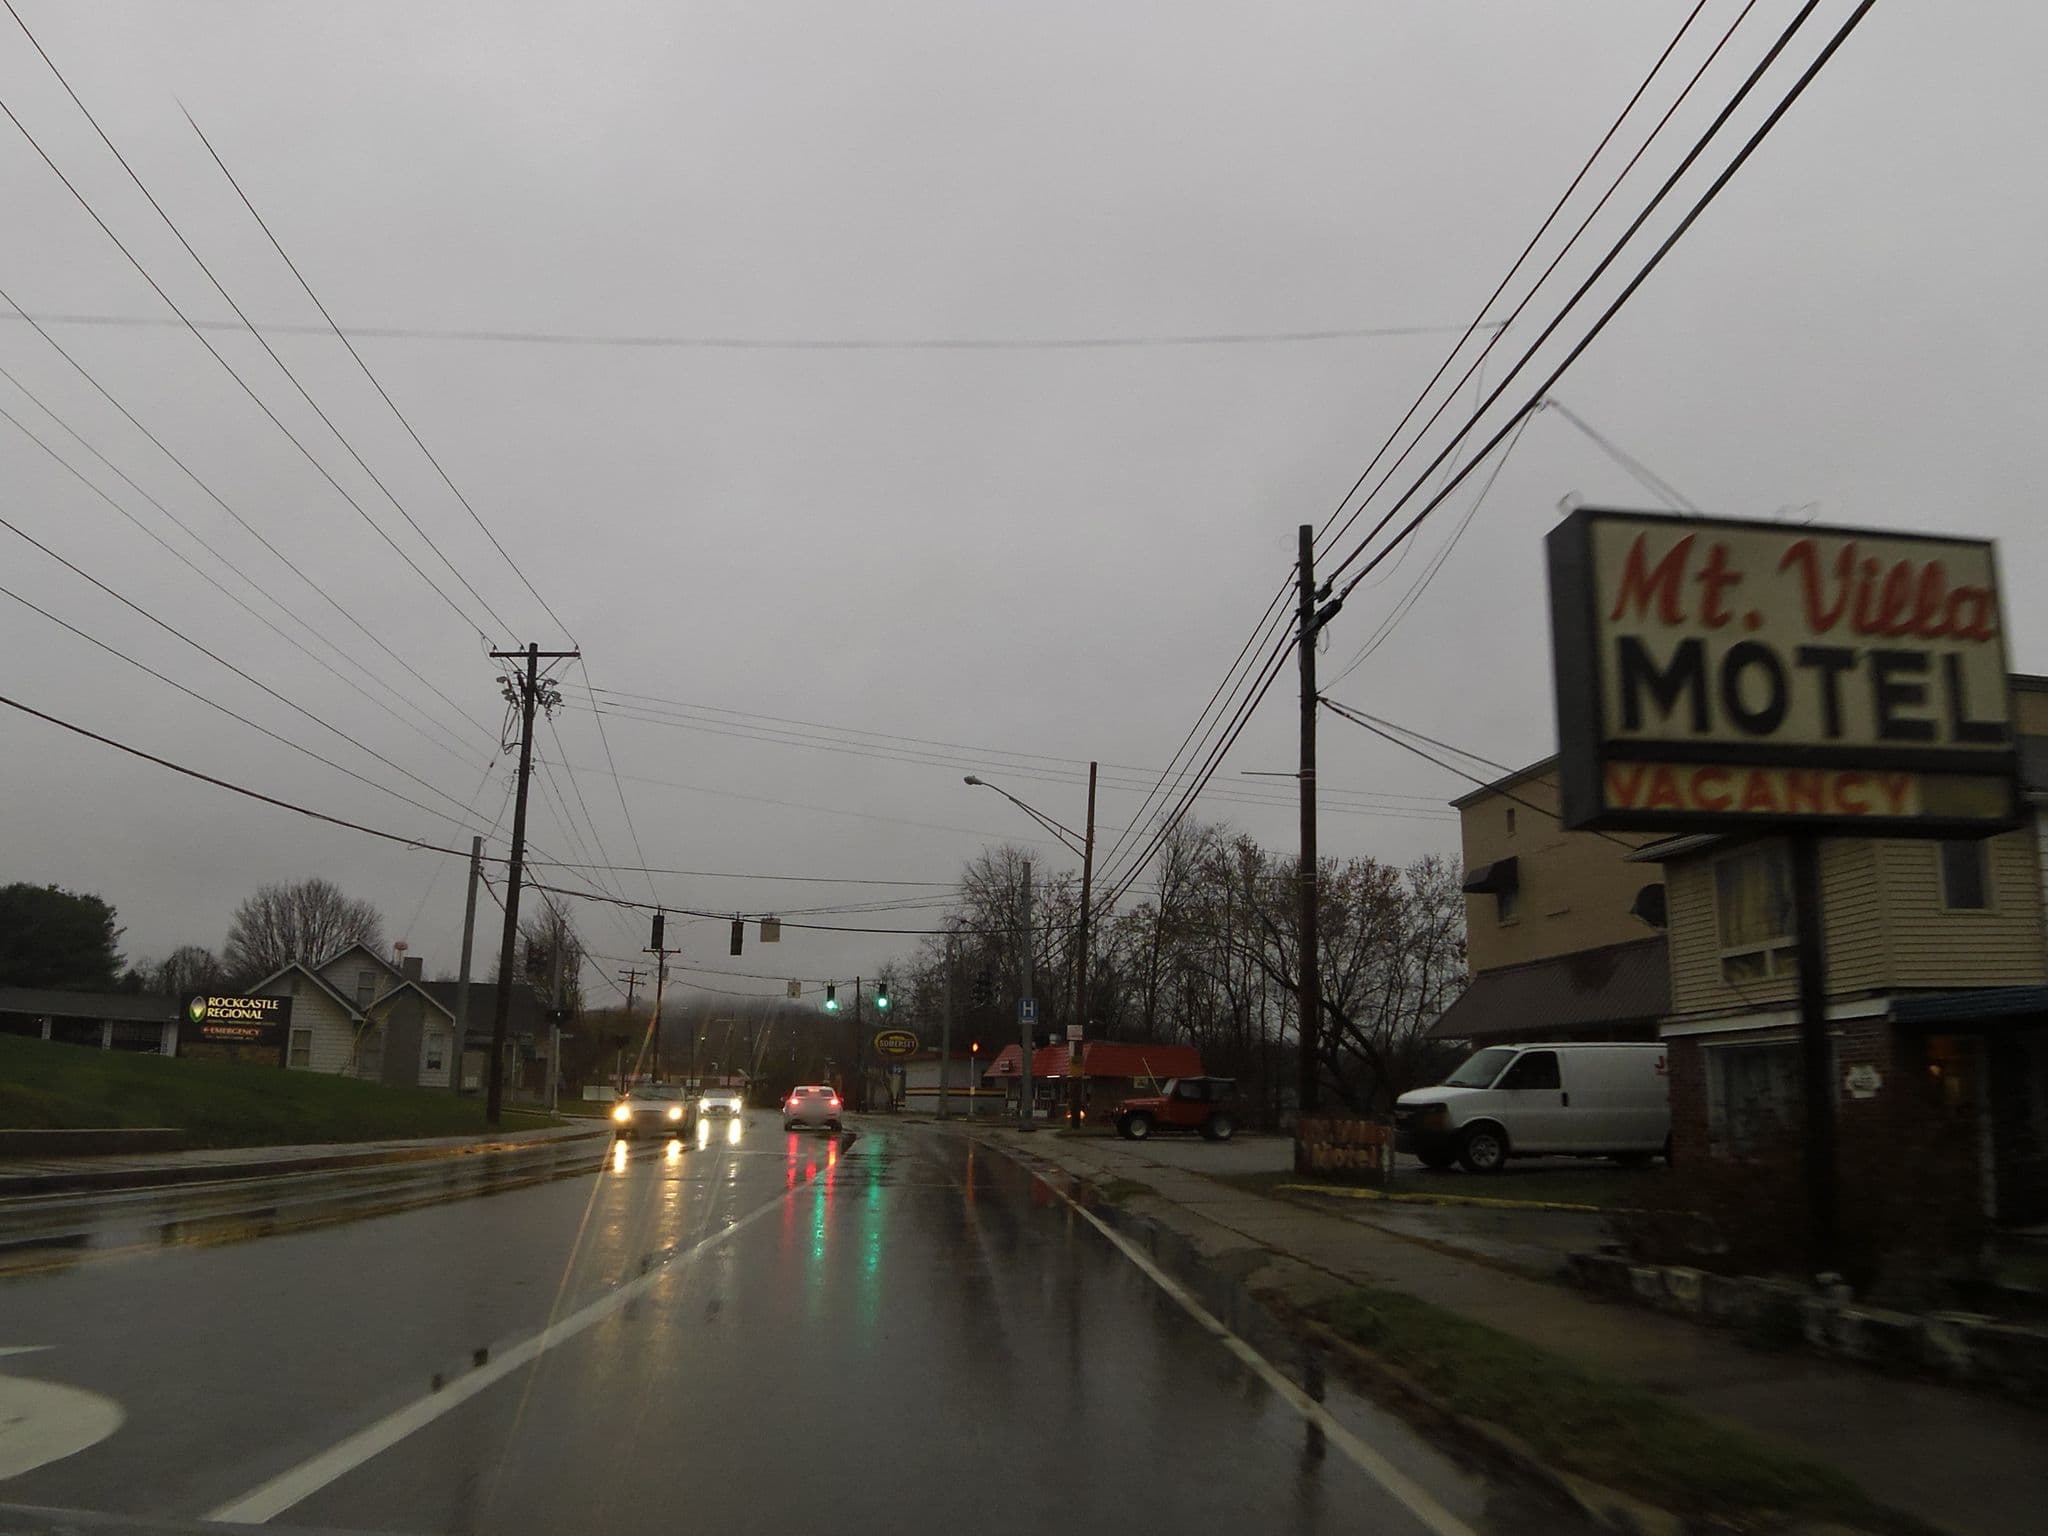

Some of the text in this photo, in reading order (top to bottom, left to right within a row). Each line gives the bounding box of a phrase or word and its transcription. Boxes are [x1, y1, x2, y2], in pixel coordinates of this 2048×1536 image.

[1611, 532, 1999, 642] Mt. Villa
[1616, 635, 2012, 743] MOTEL
[1606, 764, 1914, 815] VACANCY
[208, 997, 280, 1010] ROCKCASTLE
[1023, 1000, 1034, 1017] H
[207, 1008, 264, 1020] REGIONAL
[211, 1026, 260, 1037] EMERGENCY
